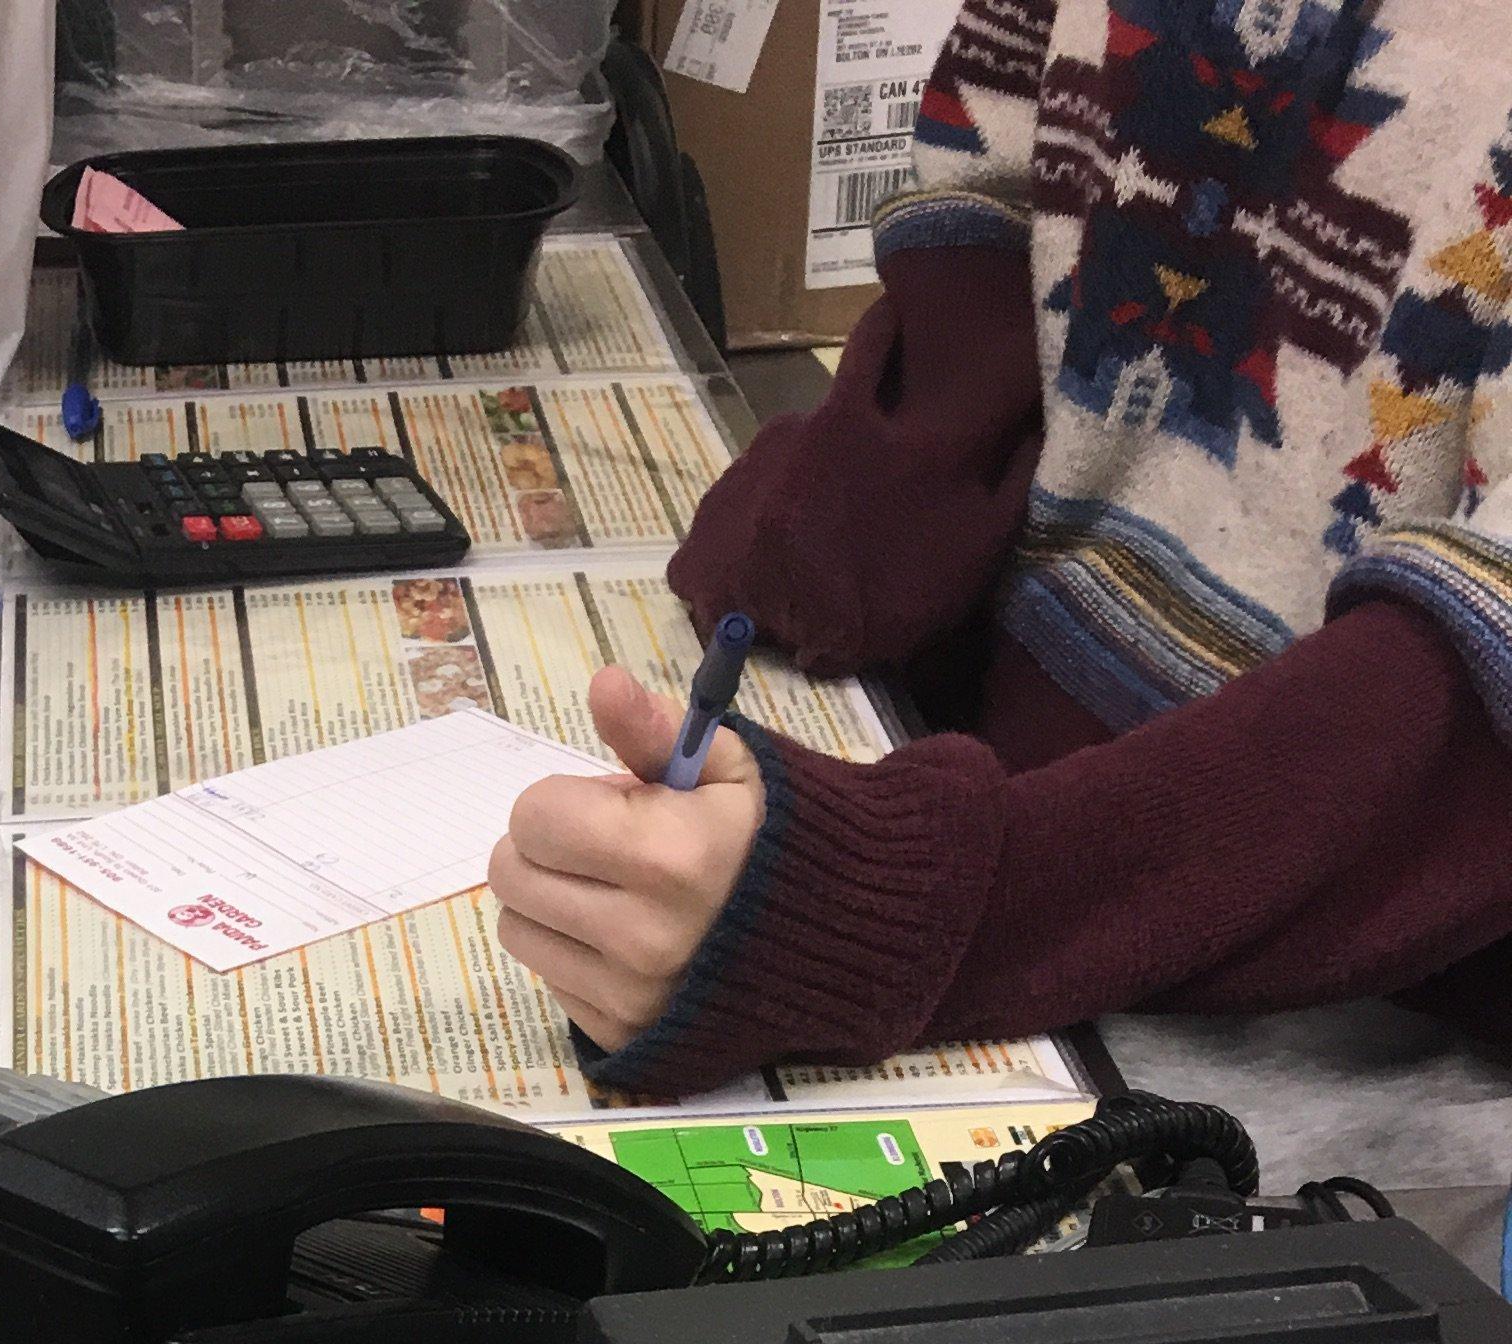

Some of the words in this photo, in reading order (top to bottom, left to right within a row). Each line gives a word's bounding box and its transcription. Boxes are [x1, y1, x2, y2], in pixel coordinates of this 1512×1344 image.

[880, 81, 907, 99] CAN
[819, 145, 841, 158] UPS
[846, 139, 906, 155] STANDARD
[51, 837, 125, 881] 905-951-1688
[197, 894, 262, 928] GARDEN
[212, 921, 268, 950] PANDA
[467, 935, 482, 972] Chicken
[499, 951, 513, 986] Shrimp
[273, 968, 282, 988] Ribs
[315, 981, 327, 1003] Beef
[477, 975, 491, 1009] Pepper
[16, 980, 26, 1030] GARDEN
[102, 984, 111, 1019] Noodle
[277, 991, 287, 1013] Sour
[333, 990, 345, 1028] Chicken
[454, 997, 468, 1036] Chicken
[483, 1012, 493, 1020] &
[506, 987, 521, 1017] Island
[104, 1020, 113, 1051] Hakka
[278, 1015, 288, 1023] &
[320, 1005, 335, 1055] Pineapple
[349, 1002, 361, 1041] Chicken
[388, 1011, 401, 1034] Beef
[440, 1010, 453, 1033] Beef
[487, 1022, 498, 1041] Salt
[16, 1032, 26, 1074] PANDA
[281, 1026, 293, 1058] Sweet
[338, 1031, 350, 1055] Basil
[395, 1037, 409, 1076] Sesame
[447, 1035, 462, 1074] Orange
[463, 1038, 476, 1073] Ginger
[494, 1044, 506, 1071] Spicy
[514, 1019, 534, 1069] Thousand
[105, 1053, 116, 1090] Special
[328, 1057, 337, 1074] hai
